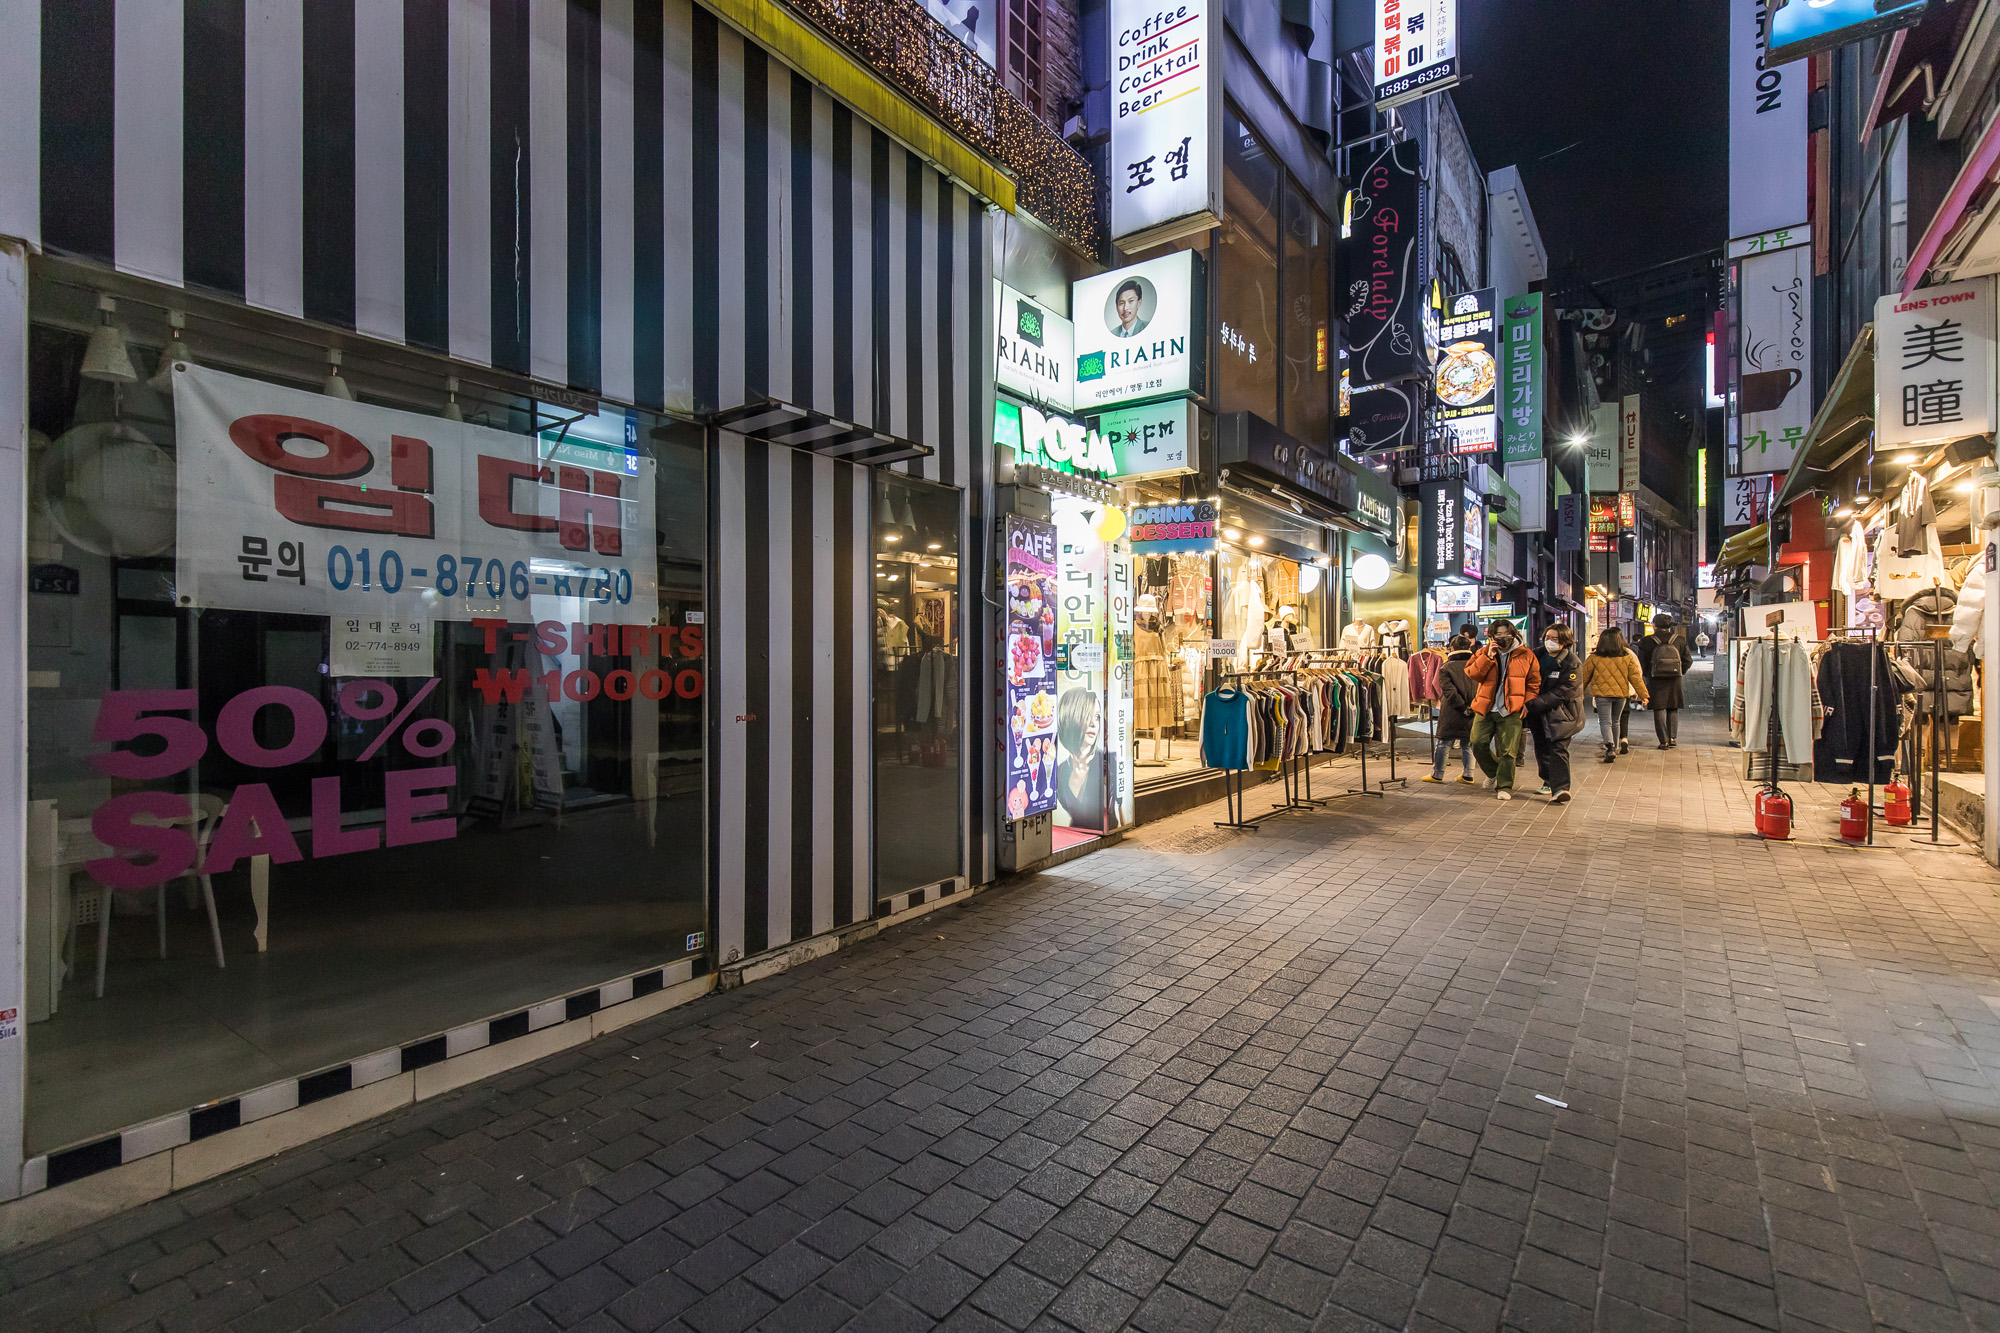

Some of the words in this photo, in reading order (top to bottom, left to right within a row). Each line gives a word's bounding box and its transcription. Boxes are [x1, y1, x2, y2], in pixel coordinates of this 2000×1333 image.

[1119, 5, 1188, 47] Coffee
[1119, 36, 1169, 71] Drink
[1119, 44, 1198, 95] Cocktail
[1380, 64, 1450, 98] 1588-6329
[1119, 89, 1163, 119] Beer
[1126, 136, 1193, 194] 포엠
[1747, 229, 1793, 253] 가무
[1364, 208, 1399, 321] Forelady
[1893, 300, 1929, 313] LENS
[1931, 291, 1976, 306] TOWN
[999, 335, 1059, 383] RIAHN
[1110, 336, 1185, 369] RIAHN
[1095, 386, 1123, 399] 리안헤어
[1130, 382, 1143, 393] 명동
[1512, 322, 1533, 427] 미도리가방
[1901, 318, 1965, 428] 美瞳
[1020, 405, 1119, 478] POEM
[1507, 431, 1537, 443] みどり
[1507, 442, 1538, 455] かばん
[1742, 425, 1807, 455] 가무
[1133, 505, 1196, 525] DRINK
[1198, 504, 1215, 521] &
[1564, 497, 1575, 528] FASCY
[1131, 521, 1215, 541] DESSERT
[237, 534, 307, 586] 문의
[327, 544, 633, 606] 010-8706-8780
[345, 641, 421, 652] 02-774-8949
[472, 617, 705, 657] T-SHIRTS
[472, 668, 706, 705] ₩10000
[88, 677, 457, 781] 50%
[85, 766, 458, 890] SALE
